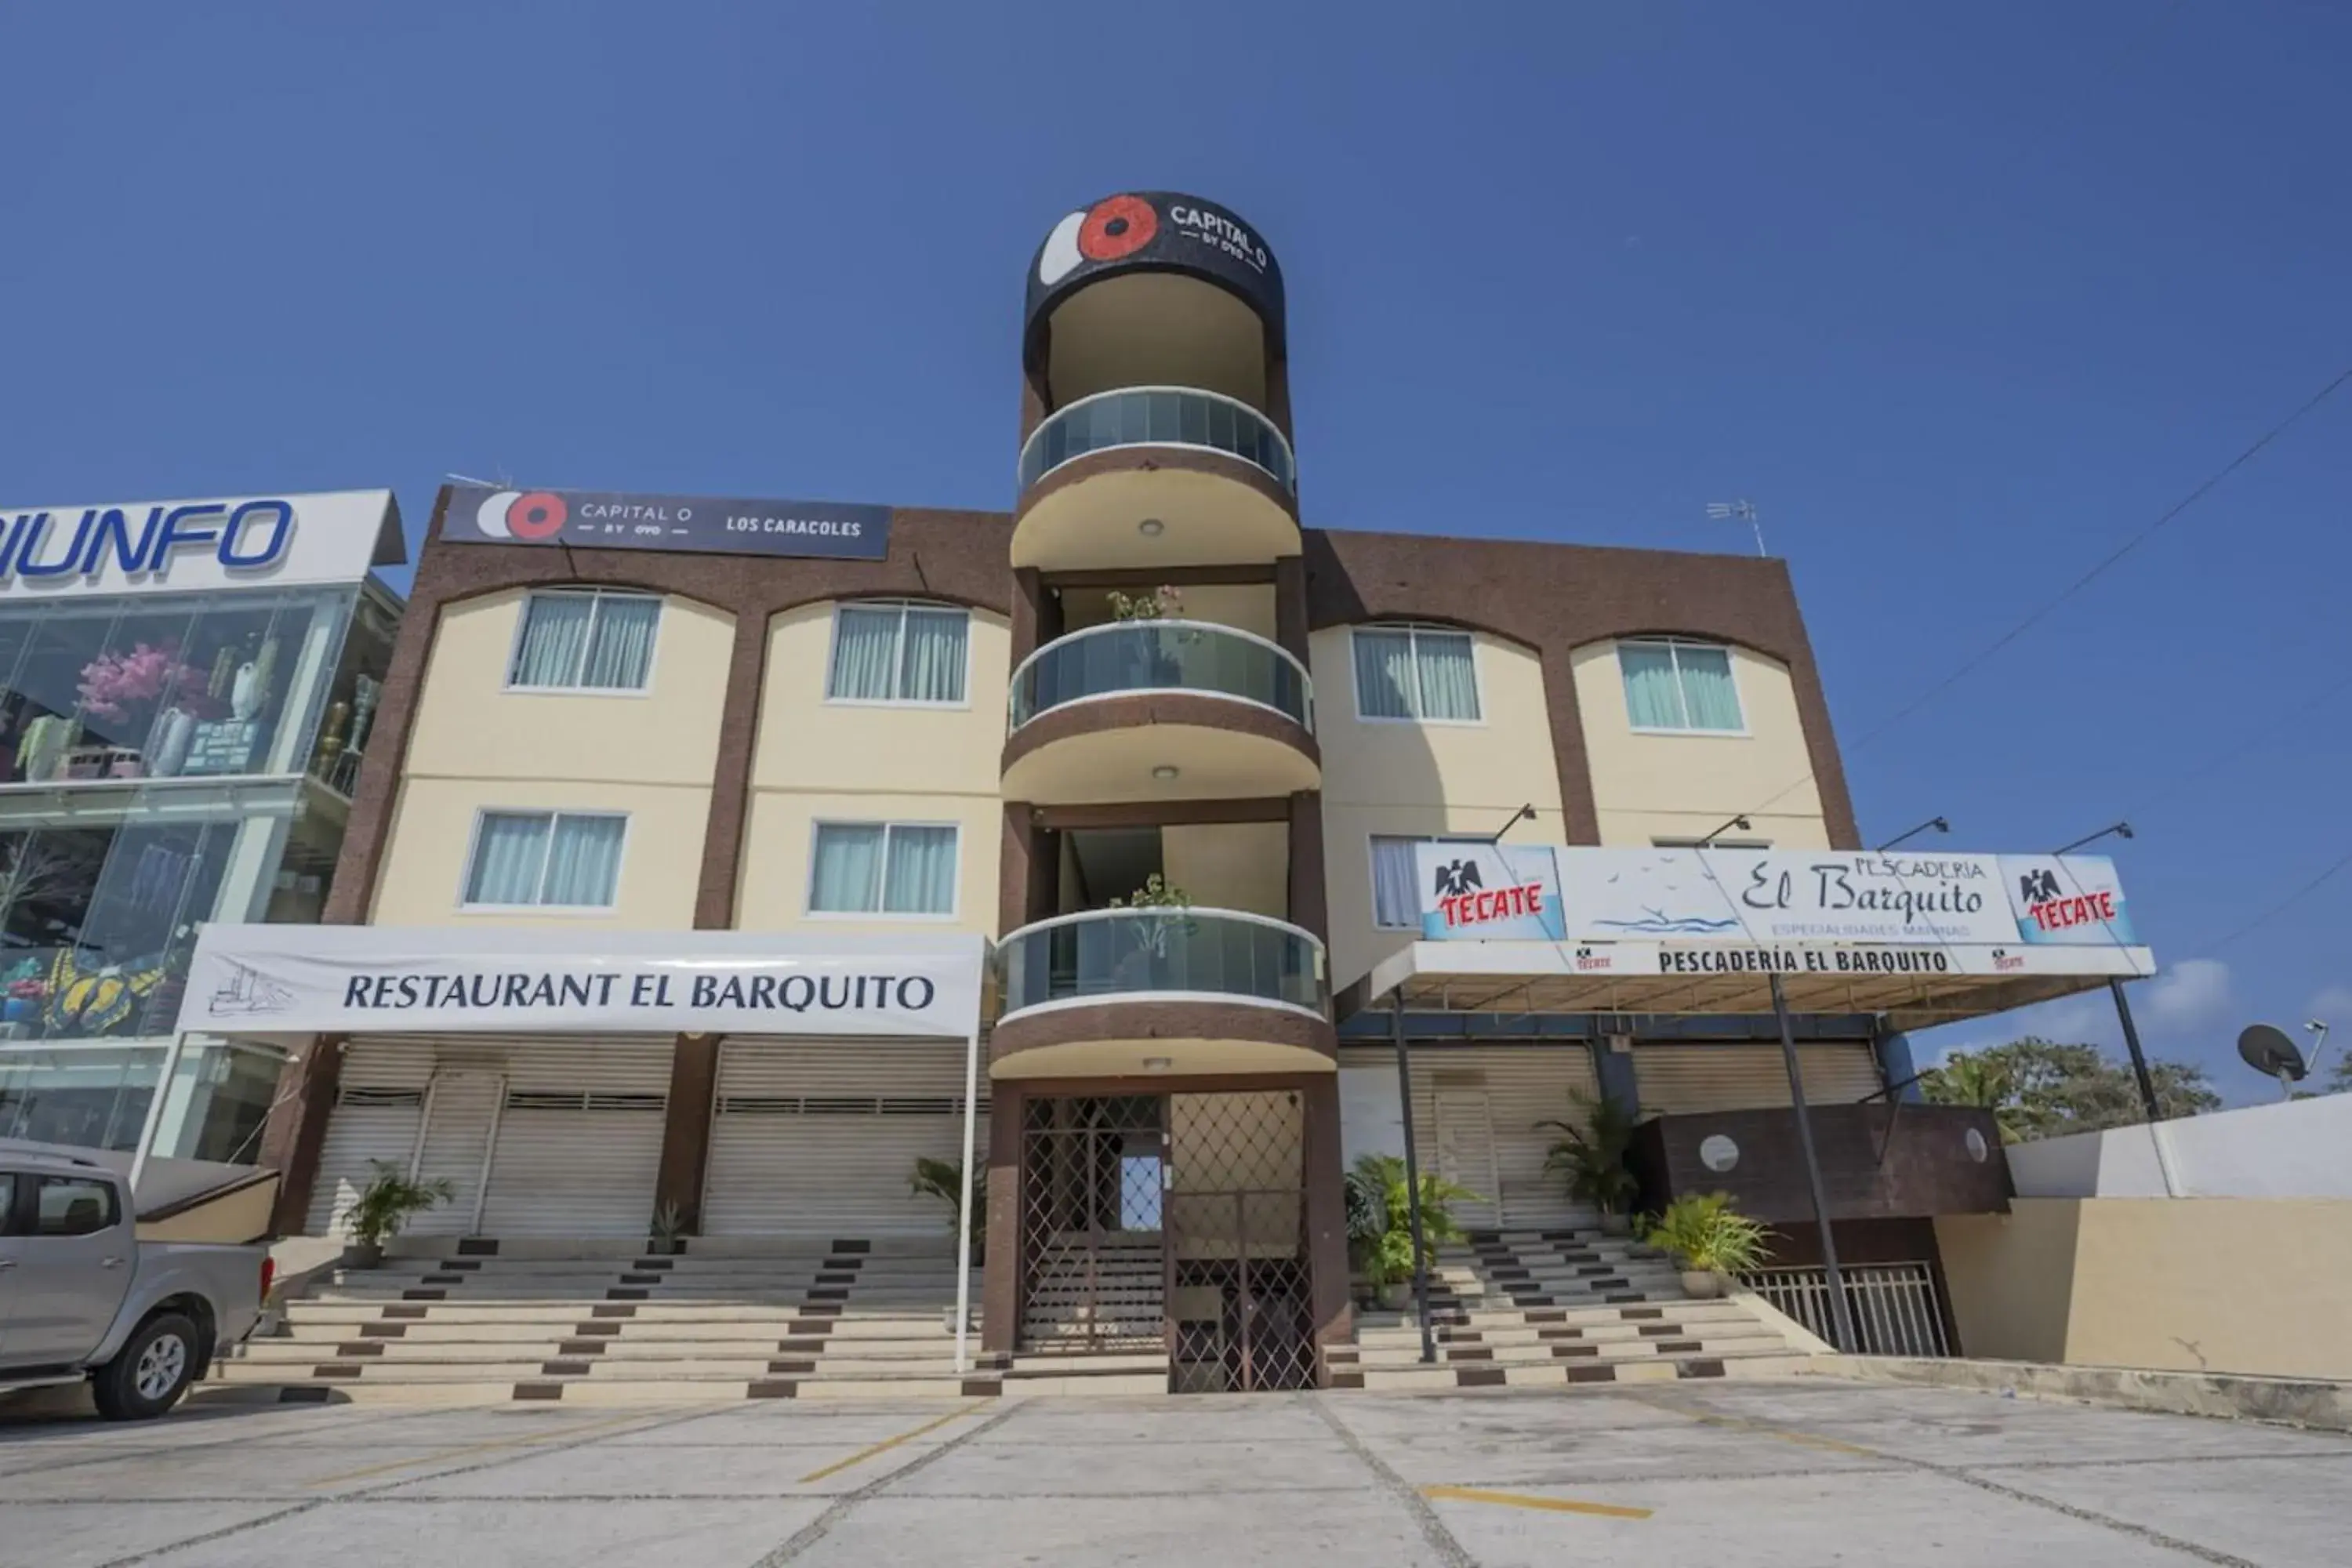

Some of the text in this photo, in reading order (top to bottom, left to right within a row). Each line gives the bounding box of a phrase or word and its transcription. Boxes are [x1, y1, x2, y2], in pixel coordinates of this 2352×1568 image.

[1171, 205, 1267, 267] CAPITAL O
[1203, 231, 1219, 247] BY
[580, 503, 691, 521] CAPITAL O
[604, 523, 625, 534] BY
[727, 516, 862, 537] LOS CARACOLES
[0, 500, 293, 578] IUNFO
[1438, 883, 1543, 928] TECATE
[1742, 861, 1983, 924] El Barquito
[2029, 891, 2115, 931] TECATE
[1658, 944, 1947, 974] PESCADERÍA EL BARQUITO
[343, 974, 935, 1012] RESTAURANT EL BARQUITO
